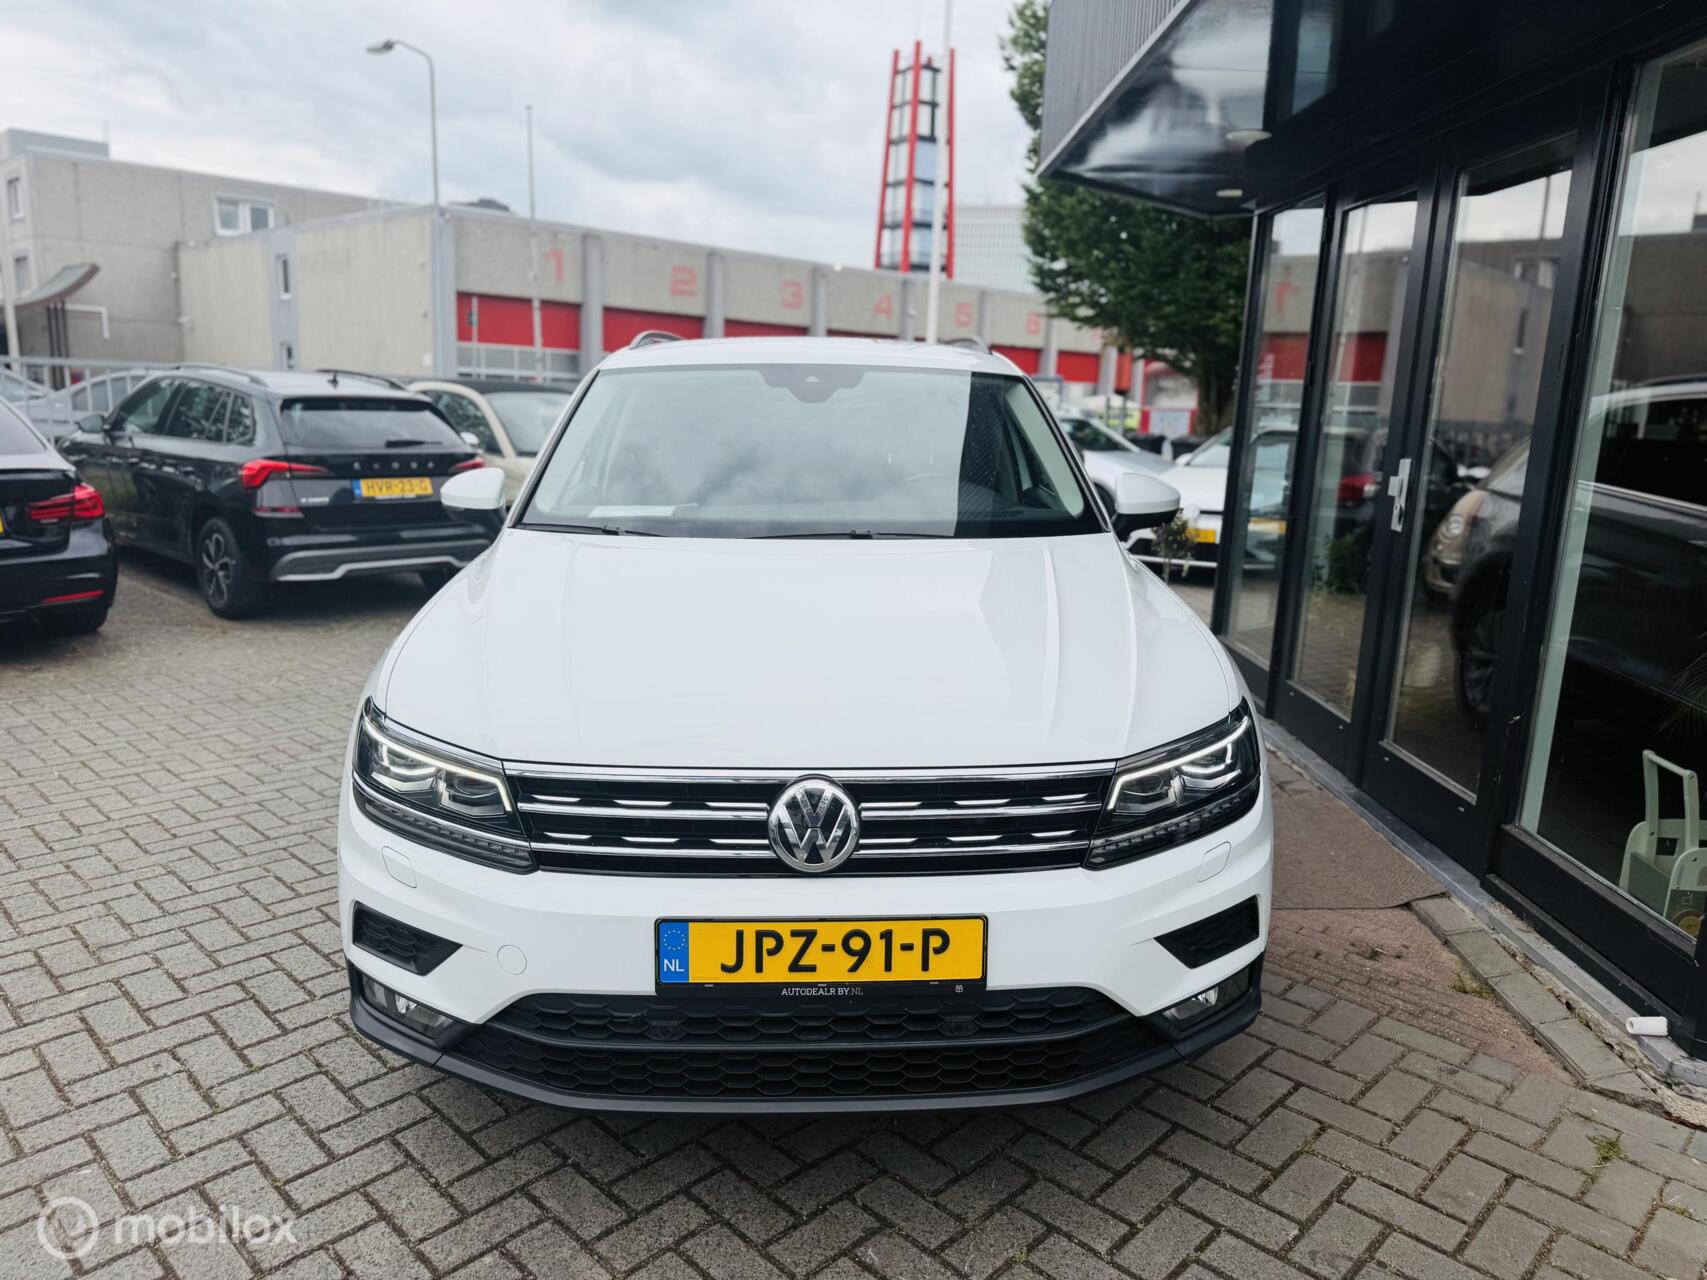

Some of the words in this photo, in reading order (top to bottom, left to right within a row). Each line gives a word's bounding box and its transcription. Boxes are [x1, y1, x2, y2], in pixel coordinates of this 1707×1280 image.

[543, 247, 566, 282] 1
[669, 265, 698, 299] 2
[781, 279, 804, 310] 3
[871, 293, 894, 321] 4
[954, 303, 974, 328] 5
[772, 781, 856, 870] VW
[663, 958, 685, 972] NL
[720, 928, 951, 974] JPZ-91-P
[781, 987, 836, 997] AUTODEALR
